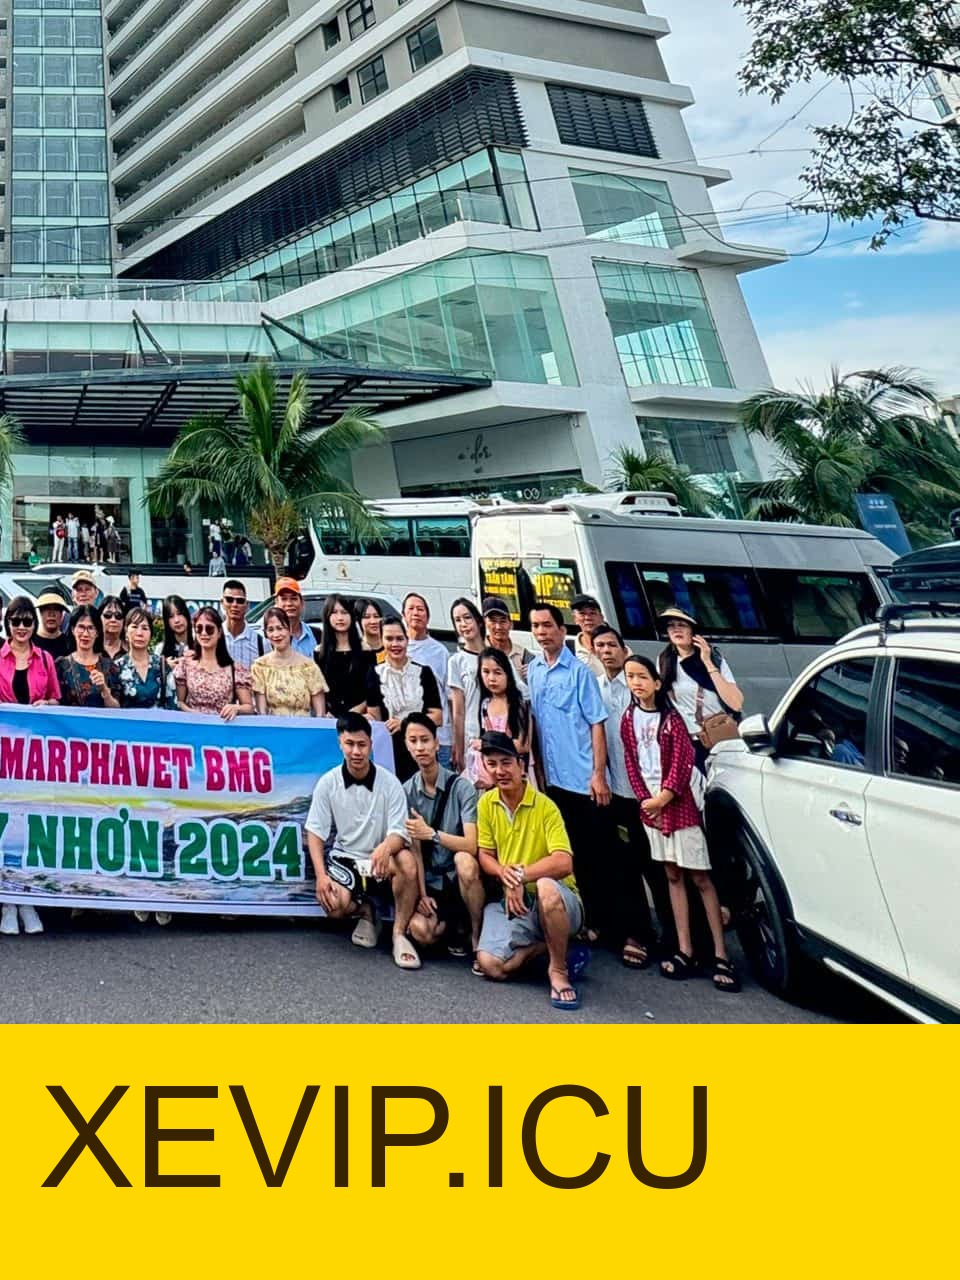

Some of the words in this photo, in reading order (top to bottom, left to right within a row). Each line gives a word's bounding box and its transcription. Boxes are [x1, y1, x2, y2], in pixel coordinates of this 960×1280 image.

[203, 748, 273, 794] BMG
[26, 807, 159, 874] NHƠN
[178, 821, 301, 878] 2024
